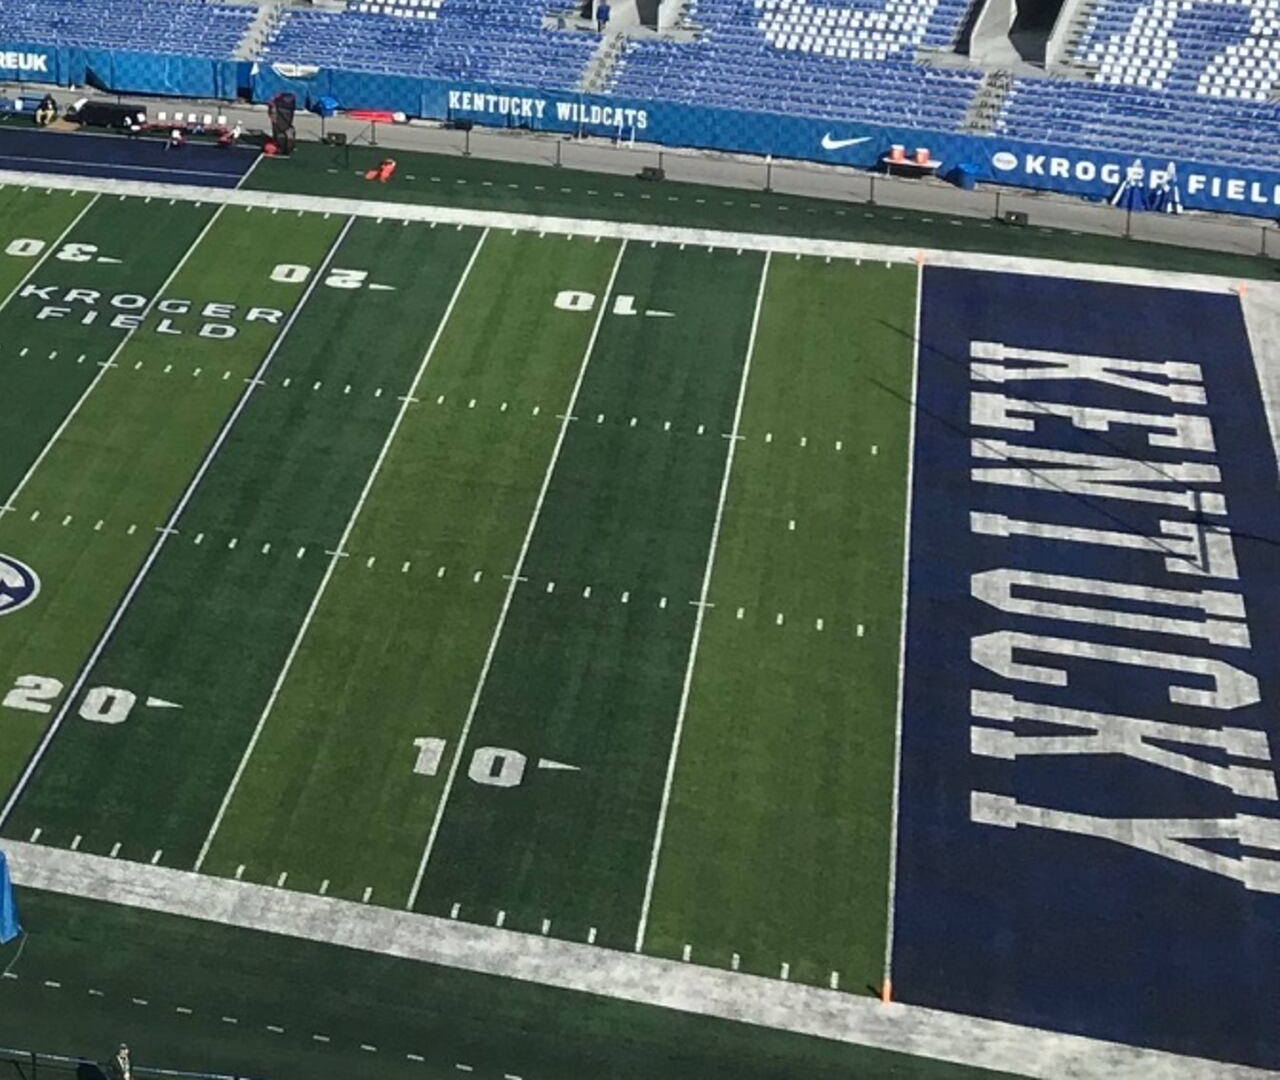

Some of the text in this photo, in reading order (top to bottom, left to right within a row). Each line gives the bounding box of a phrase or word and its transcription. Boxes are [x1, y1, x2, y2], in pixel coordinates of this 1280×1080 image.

[449, 91, 647, 128] KENTUCKY WILDCATS
[18, 284, 291, 326] KROGER
[34, 305, 241, 340] FIELD
[970, 341, 1280, 893] KENTUCKY
[1, 674, 137, 724] 20
[411, 735, 528, 789] 10
